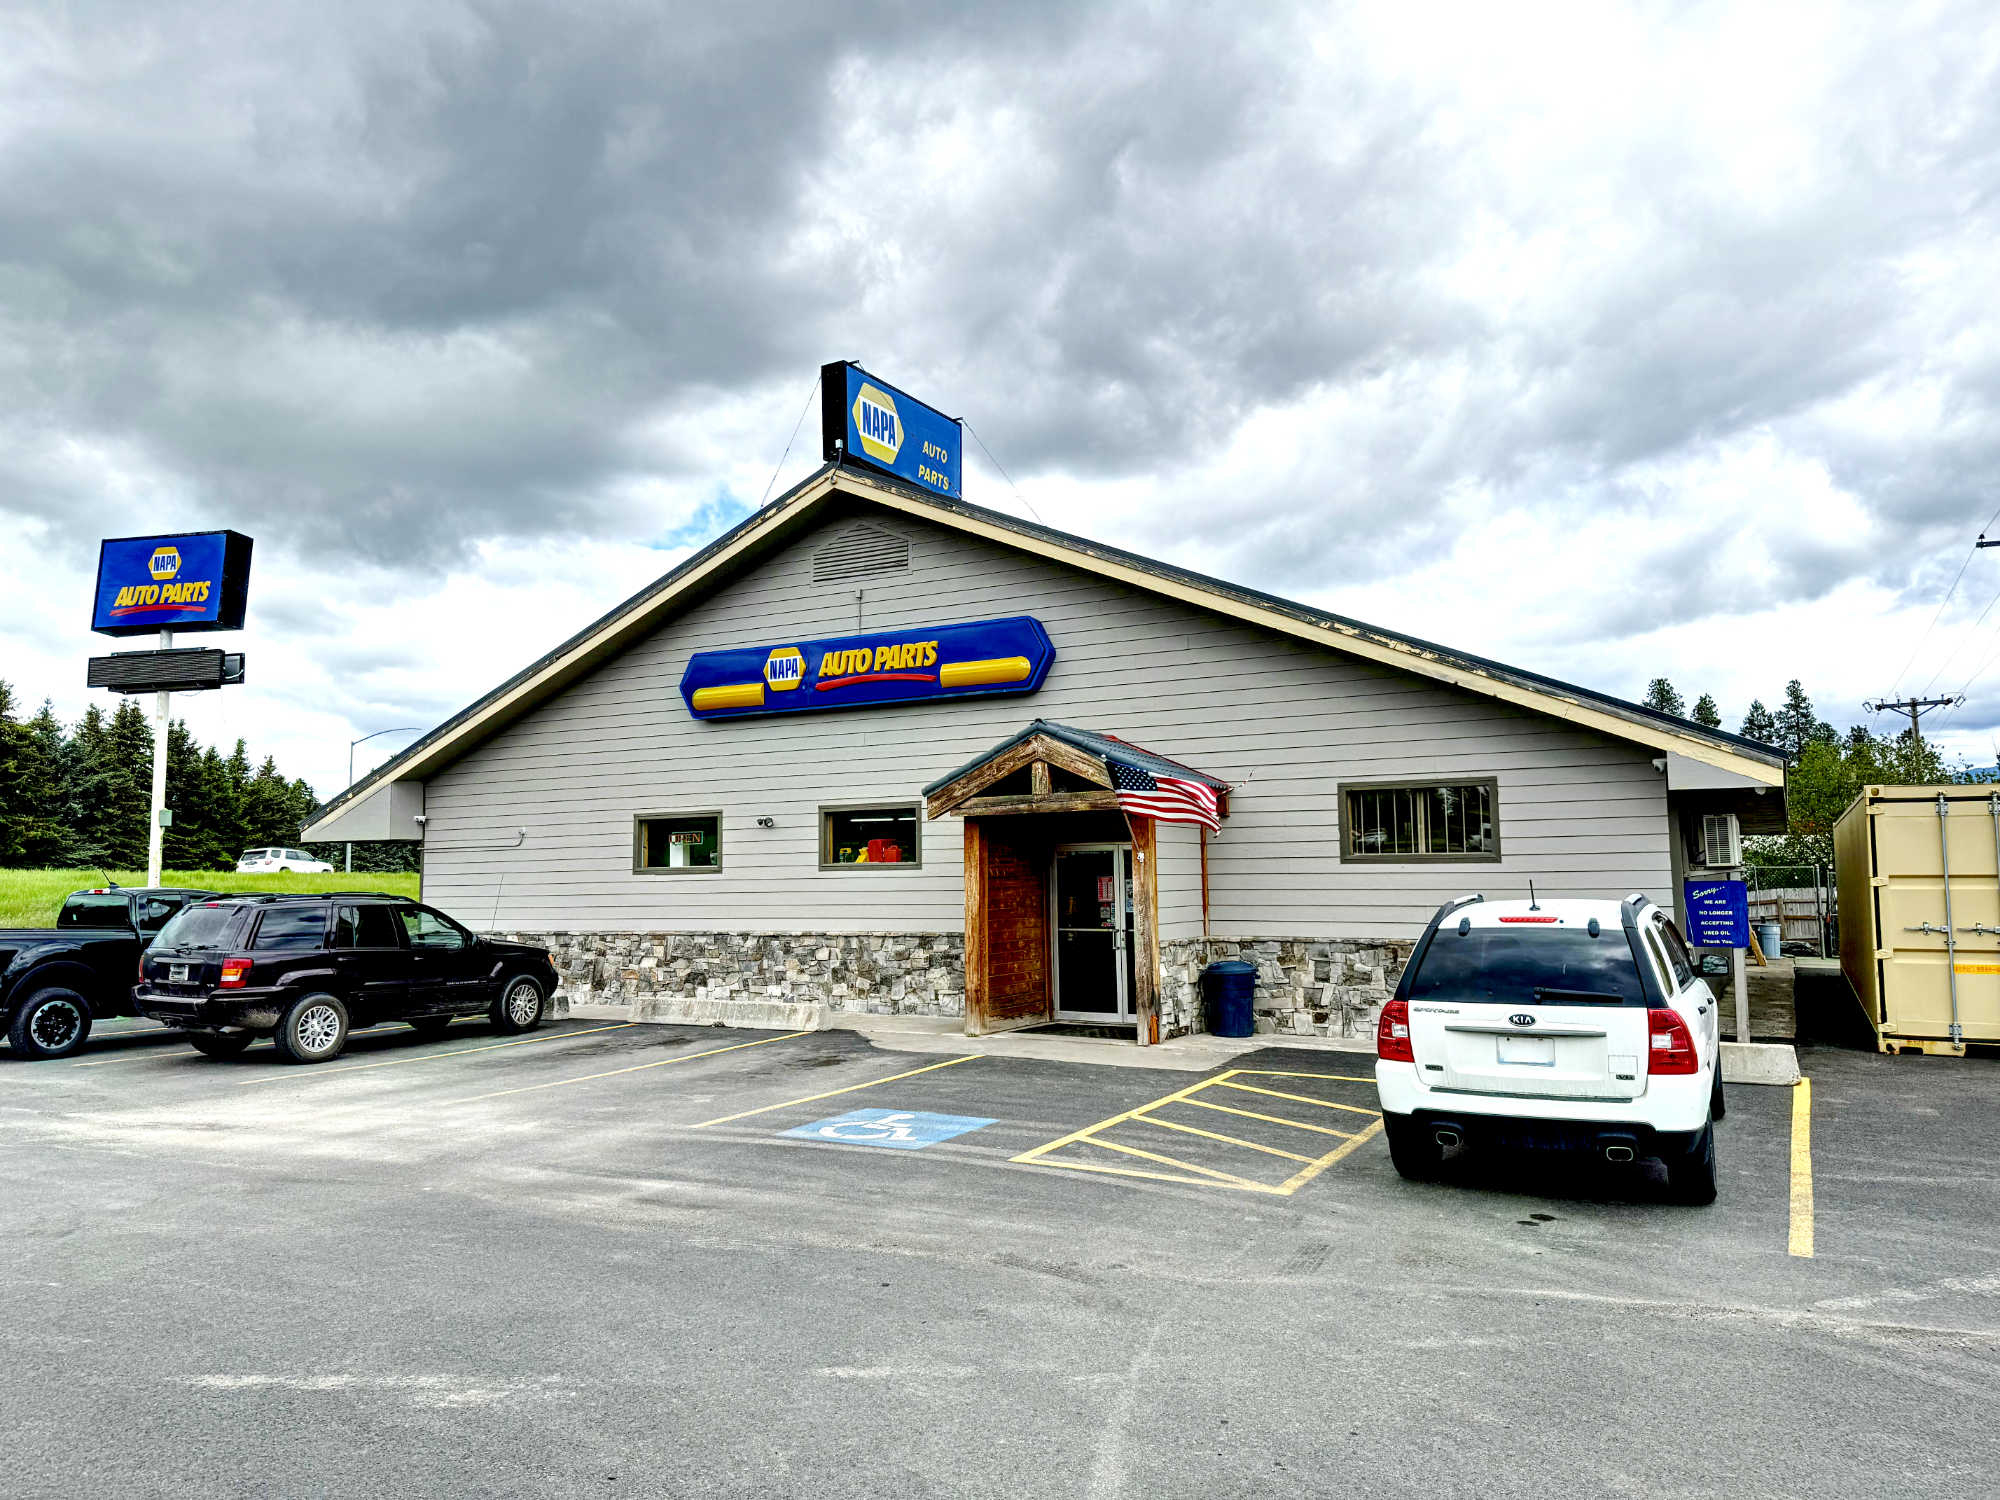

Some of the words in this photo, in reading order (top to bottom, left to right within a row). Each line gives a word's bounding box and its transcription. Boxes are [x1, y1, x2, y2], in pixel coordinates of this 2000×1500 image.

[862, 400, 896, 447] NAPA
[922, 441, 948, 464] AUTO
[918, 464, 949, 491] PARTS
[152, 554, 177, 572] NAPA
[113, 584, 160, 607] AUTO
[159, 580, 211, 604] PARTS
[768, 657, 800, 680] NAPA
[818, 648, 873, 678] AUTO
[873, 640, 939, 672] PARTS
[668, 833, 701, 843] OPEN
[1512, 1015, 1532, 1024] KIA
